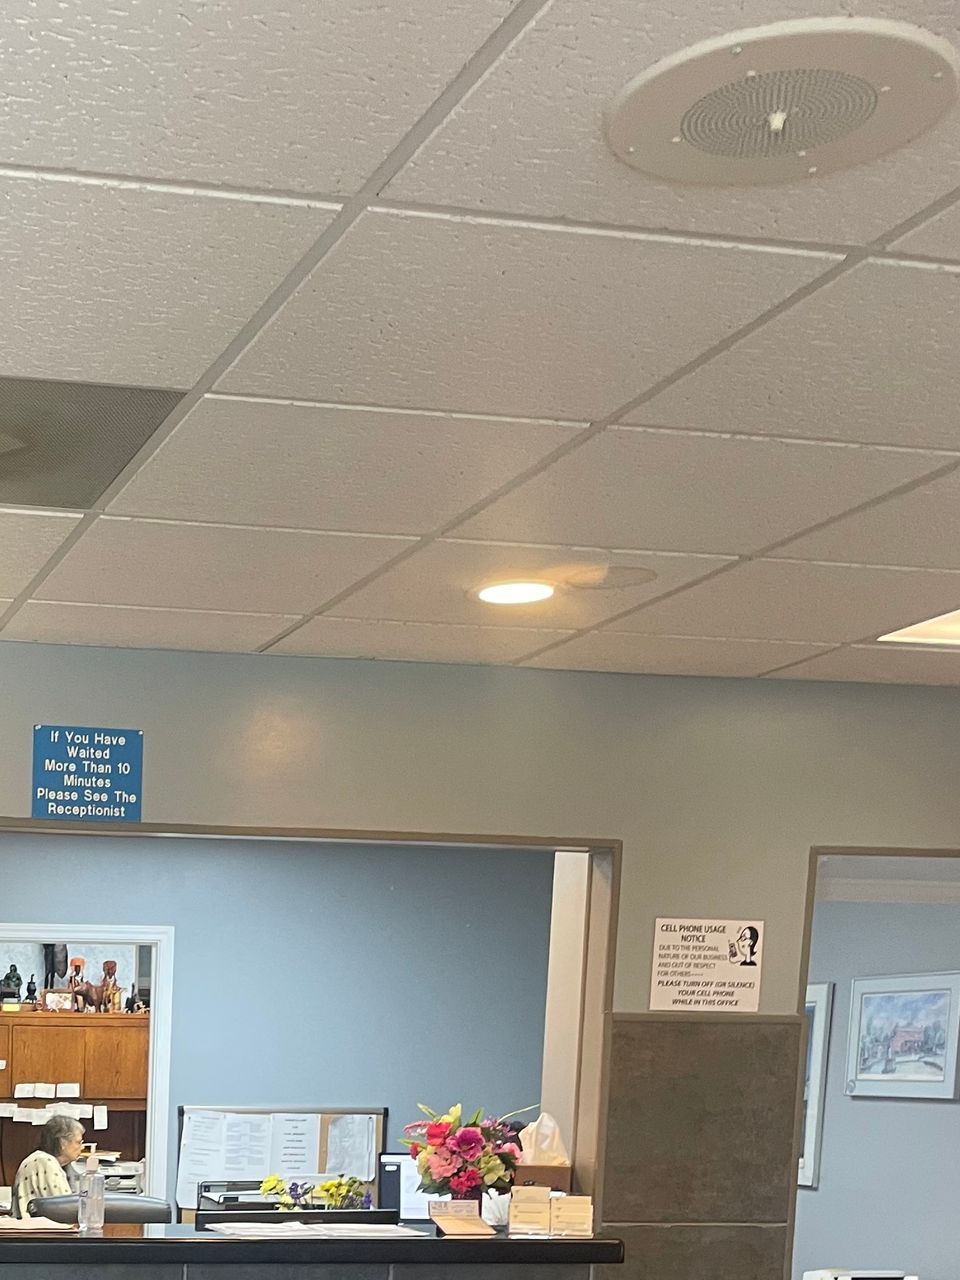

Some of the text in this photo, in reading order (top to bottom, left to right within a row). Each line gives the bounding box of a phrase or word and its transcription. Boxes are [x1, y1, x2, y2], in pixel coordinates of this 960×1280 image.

[50, 730, 126, 745] If You Have
[67, 746, 110, 759] Waited
[44, 759, 130, 774] More Than 10
[63, 774, 111, 787] Minutes
[37, 788, 137, 803] Please See The
[48, 802, 125, 817] Receptionist
[660, 924, 726, 934] CELL PHONE USAGE
[681, 934, 706, 943] NOTICE
